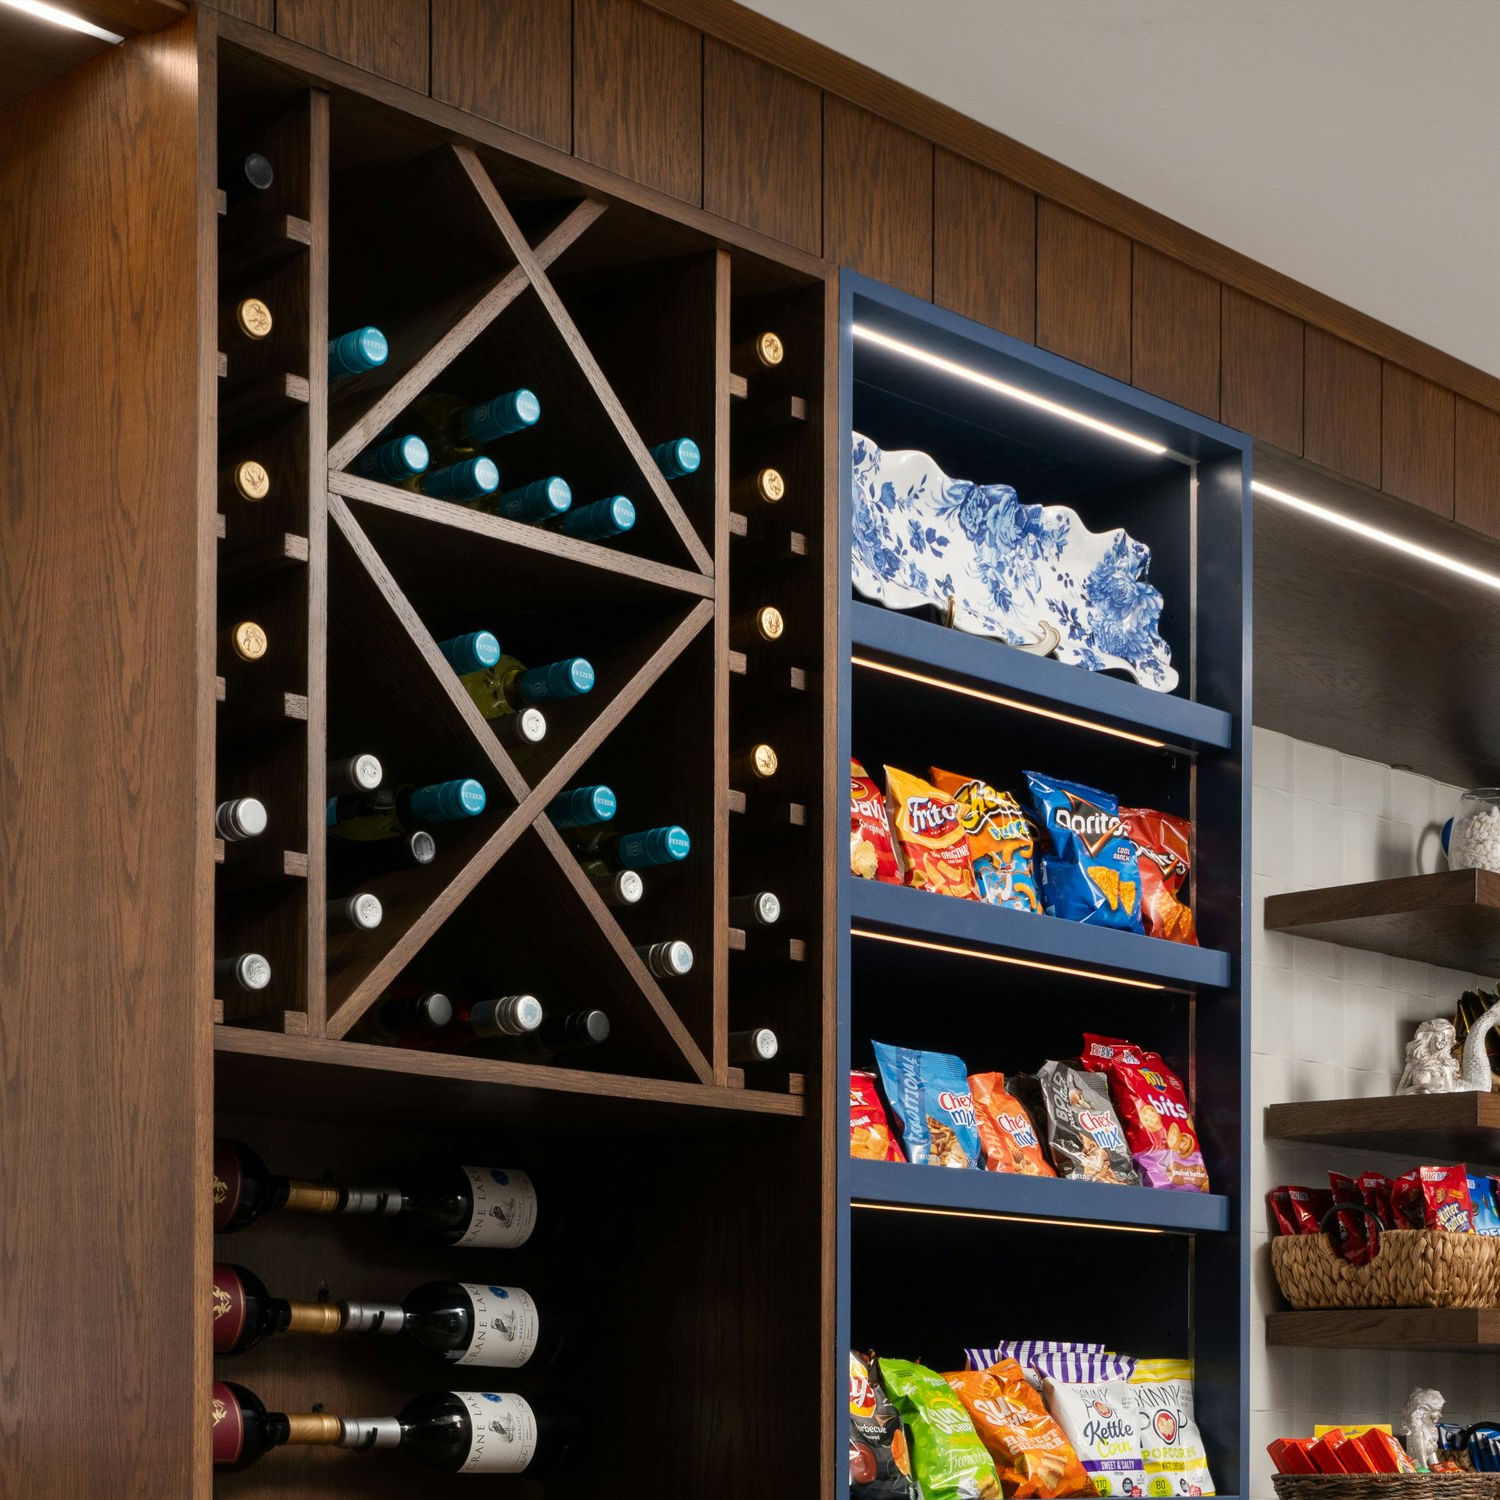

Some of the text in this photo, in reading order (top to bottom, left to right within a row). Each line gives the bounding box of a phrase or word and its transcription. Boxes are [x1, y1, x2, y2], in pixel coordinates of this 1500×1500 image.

[903, 1056, 923, 1142] TRADITIONAL
[940, 1092, 973, 1111] Chex
[1148, 1094, 1188, 1119] bits
[1079, 1111, 1113, 1131] Chex
[1437, 1202, 1460, 1226] Nutter
[463, 1321, 487, 1364] CRANE
[1083, 1419, 1133, 1446] Kettle
[465, 1424, 485, 1471] CRANE
[1098, 1439, 1132, 1457] Corn
[1142, 1446, 1196, 1460] POPCORN
[1101, 1461, 1135, 1470] SWEET SALTY
[1156, 1480, 1165, 1490] 80
